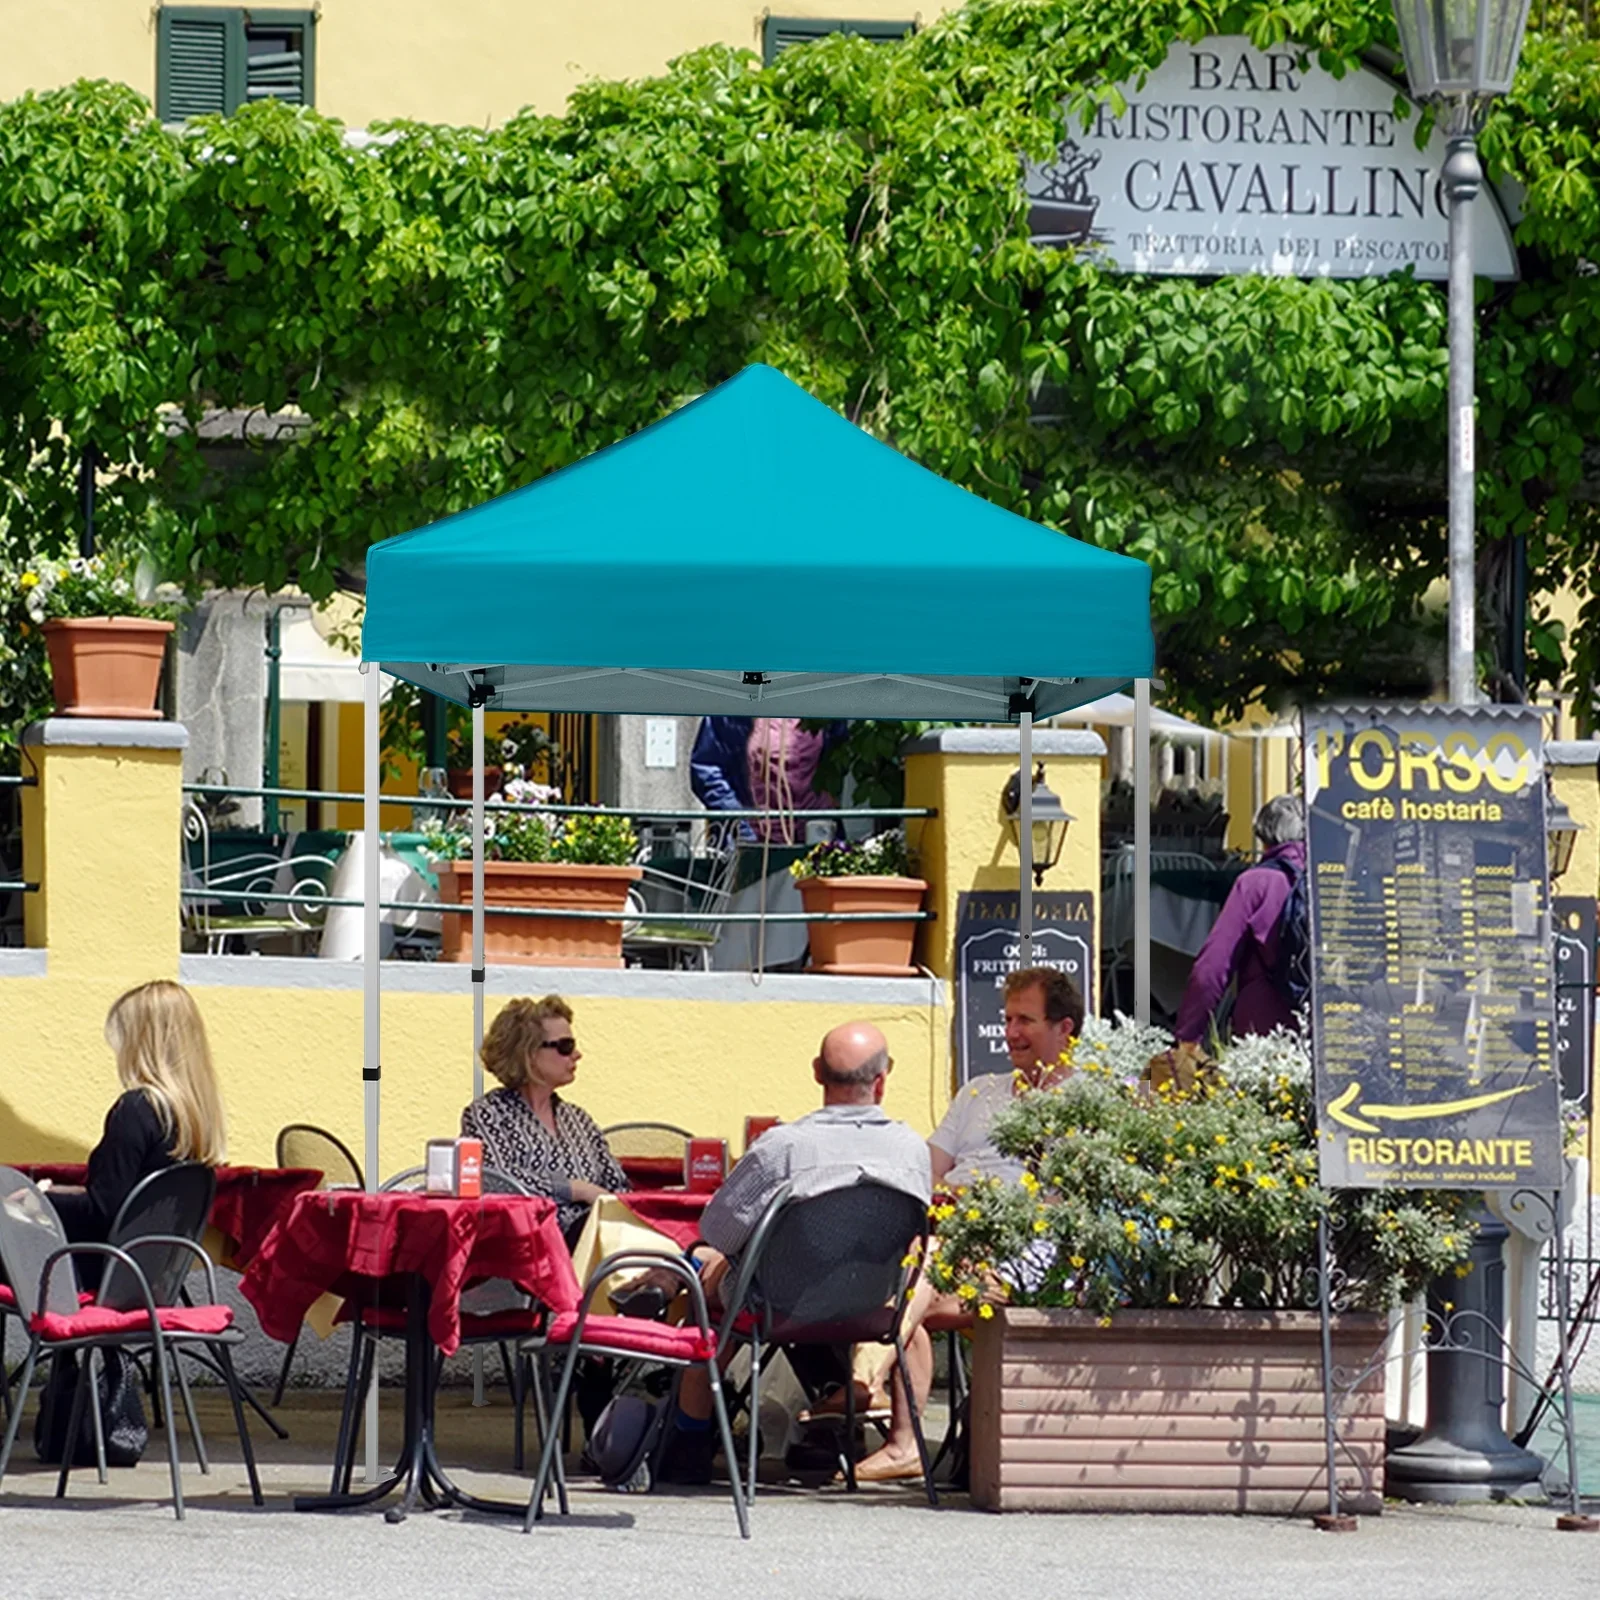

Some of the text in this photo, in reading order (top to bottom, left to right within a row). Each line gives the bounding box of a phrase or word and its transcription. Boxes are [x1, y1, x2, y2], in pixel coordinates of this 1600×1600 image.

[1190, 52, 1301, 92] BAR
[1093, 102, 1396, 148] RISTORANTE
[1125, 159, 1449, 220] CAVALLIN
[1128, 232, 1448, 261] TRATTORIA DEI PESCATO
[1401, 799, 1502, 821] hostaria
[1347, 1138, 1533, 1166] RISTORANTE
